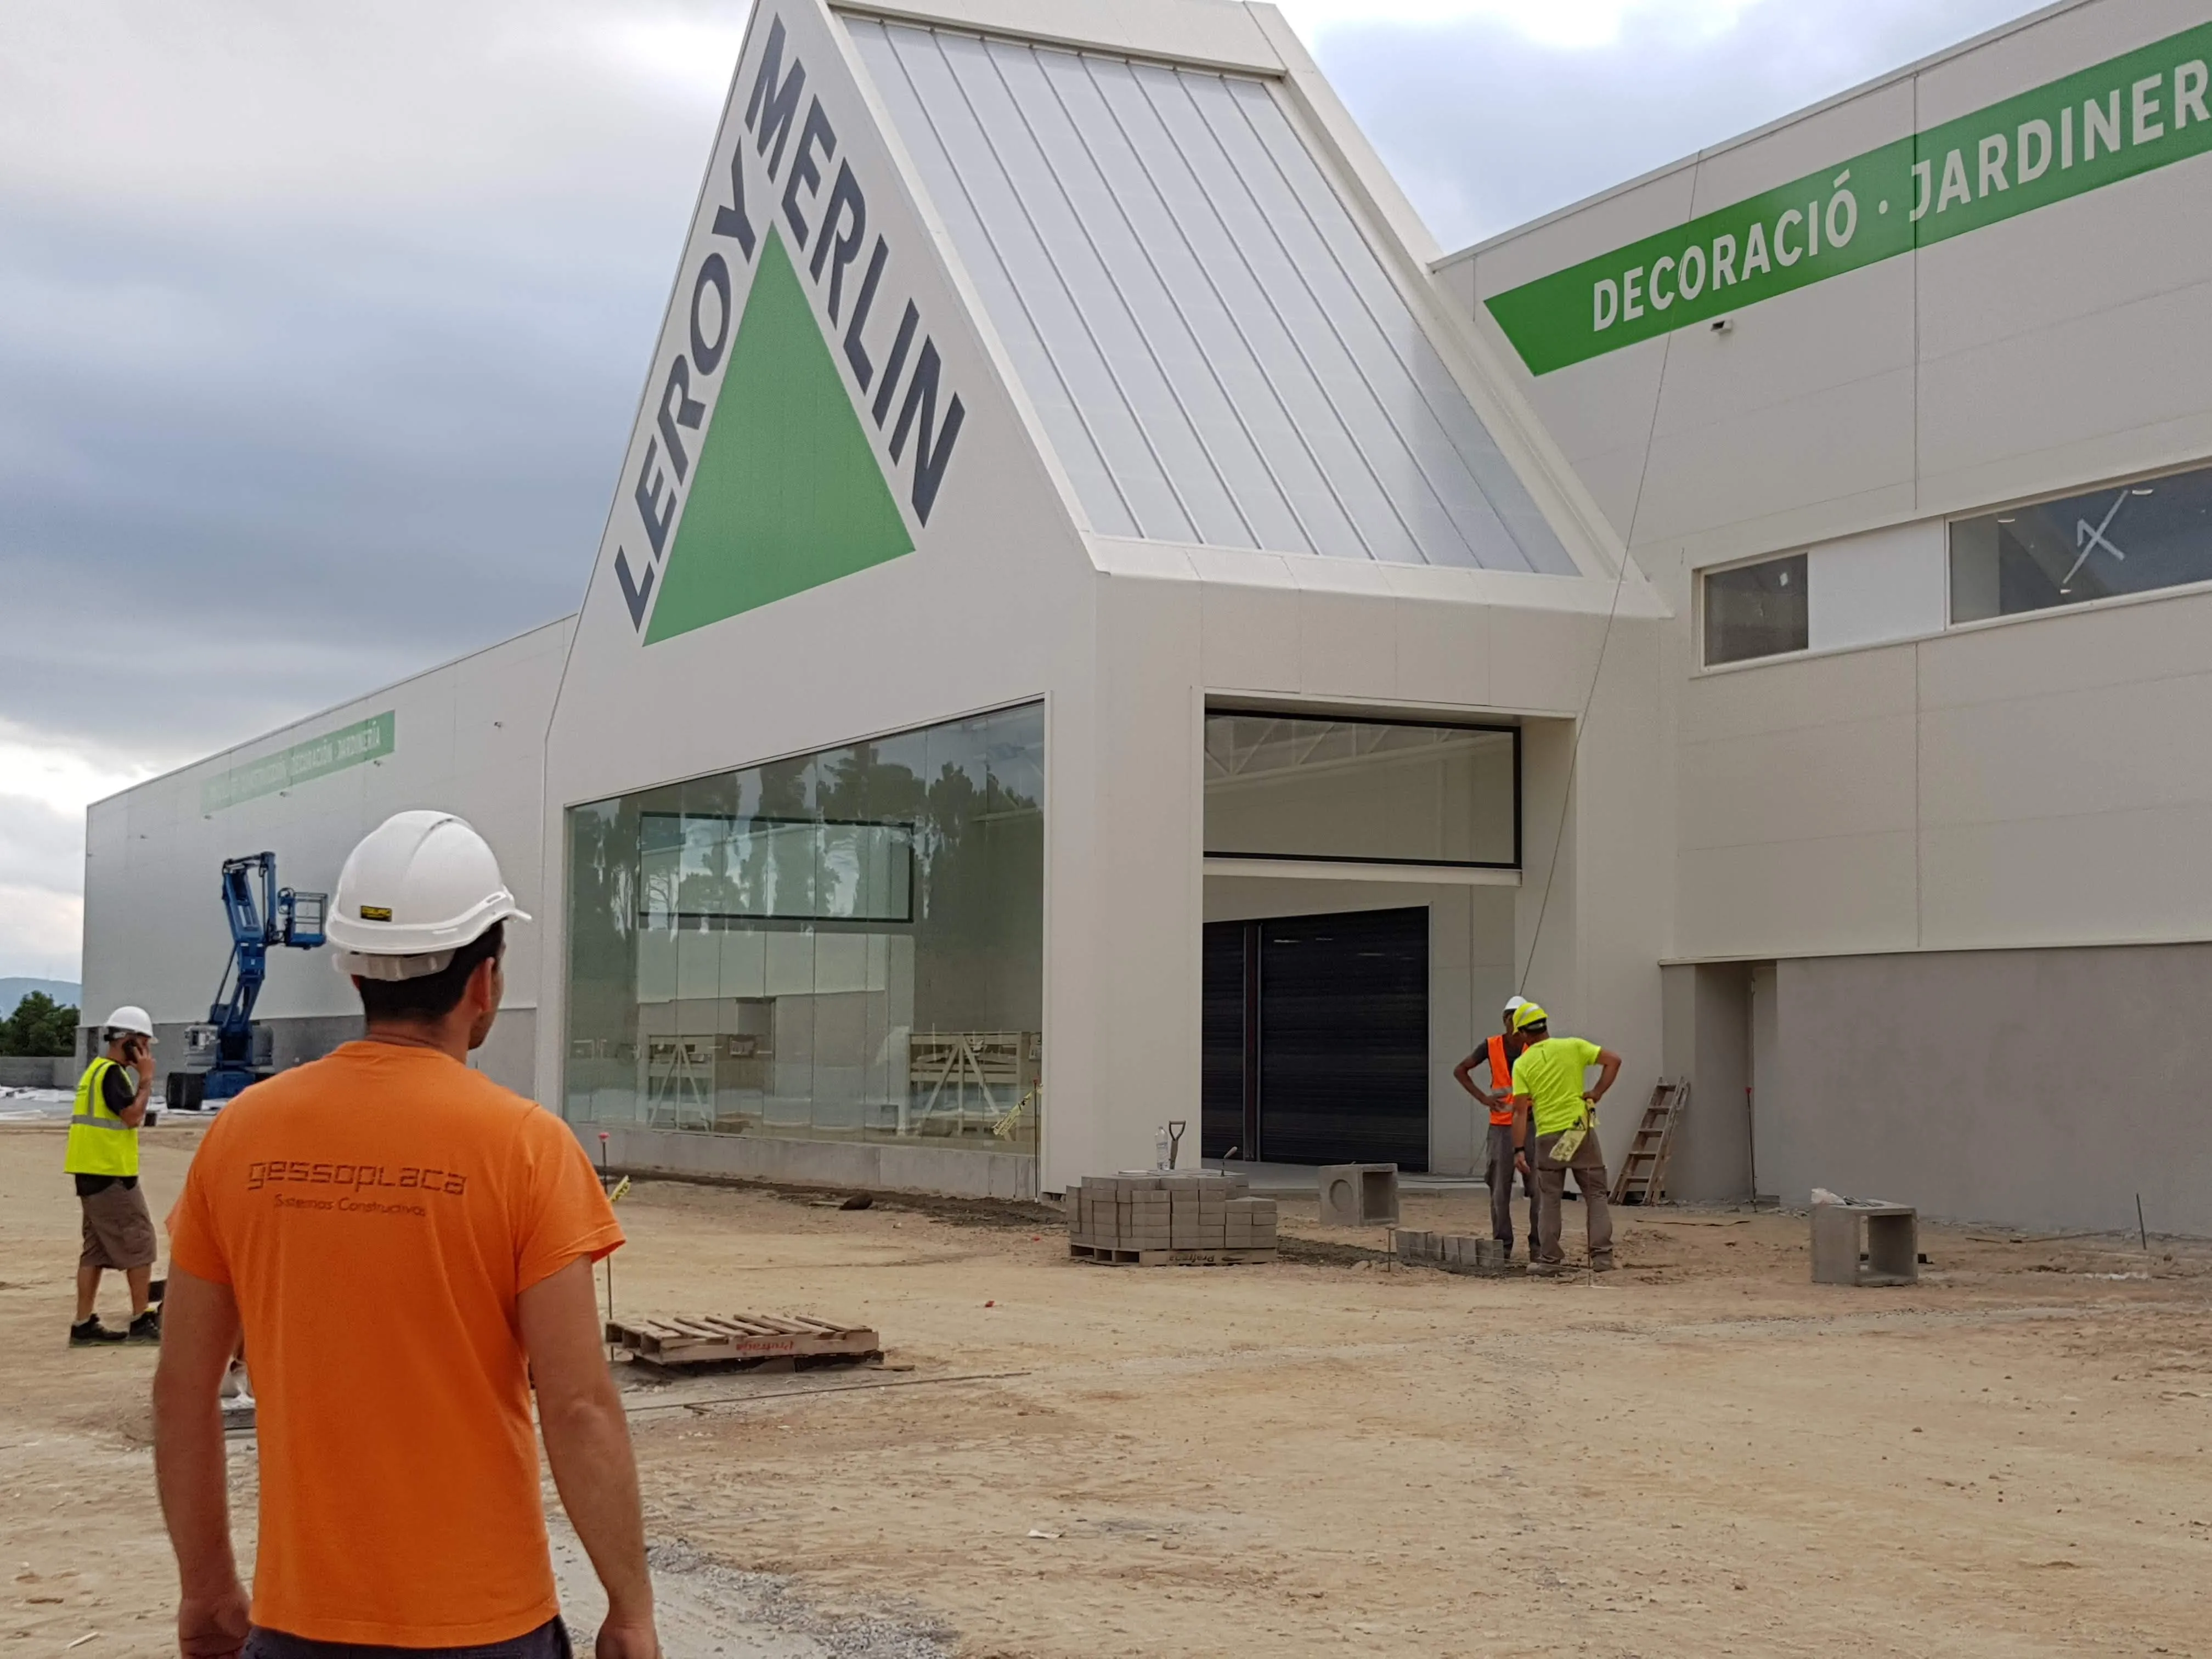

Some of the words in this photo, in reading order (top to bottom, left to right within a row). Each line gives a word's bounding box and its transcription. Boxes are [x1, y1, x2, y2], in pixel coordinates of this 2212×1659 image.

[614, 136, 756, 634] LEROY
[745, 12, 965, 528] MERLIN
[1593, 170, 1858, 331] DECORACIÓ
[1909, 59, 2211, 222] JARDINER
